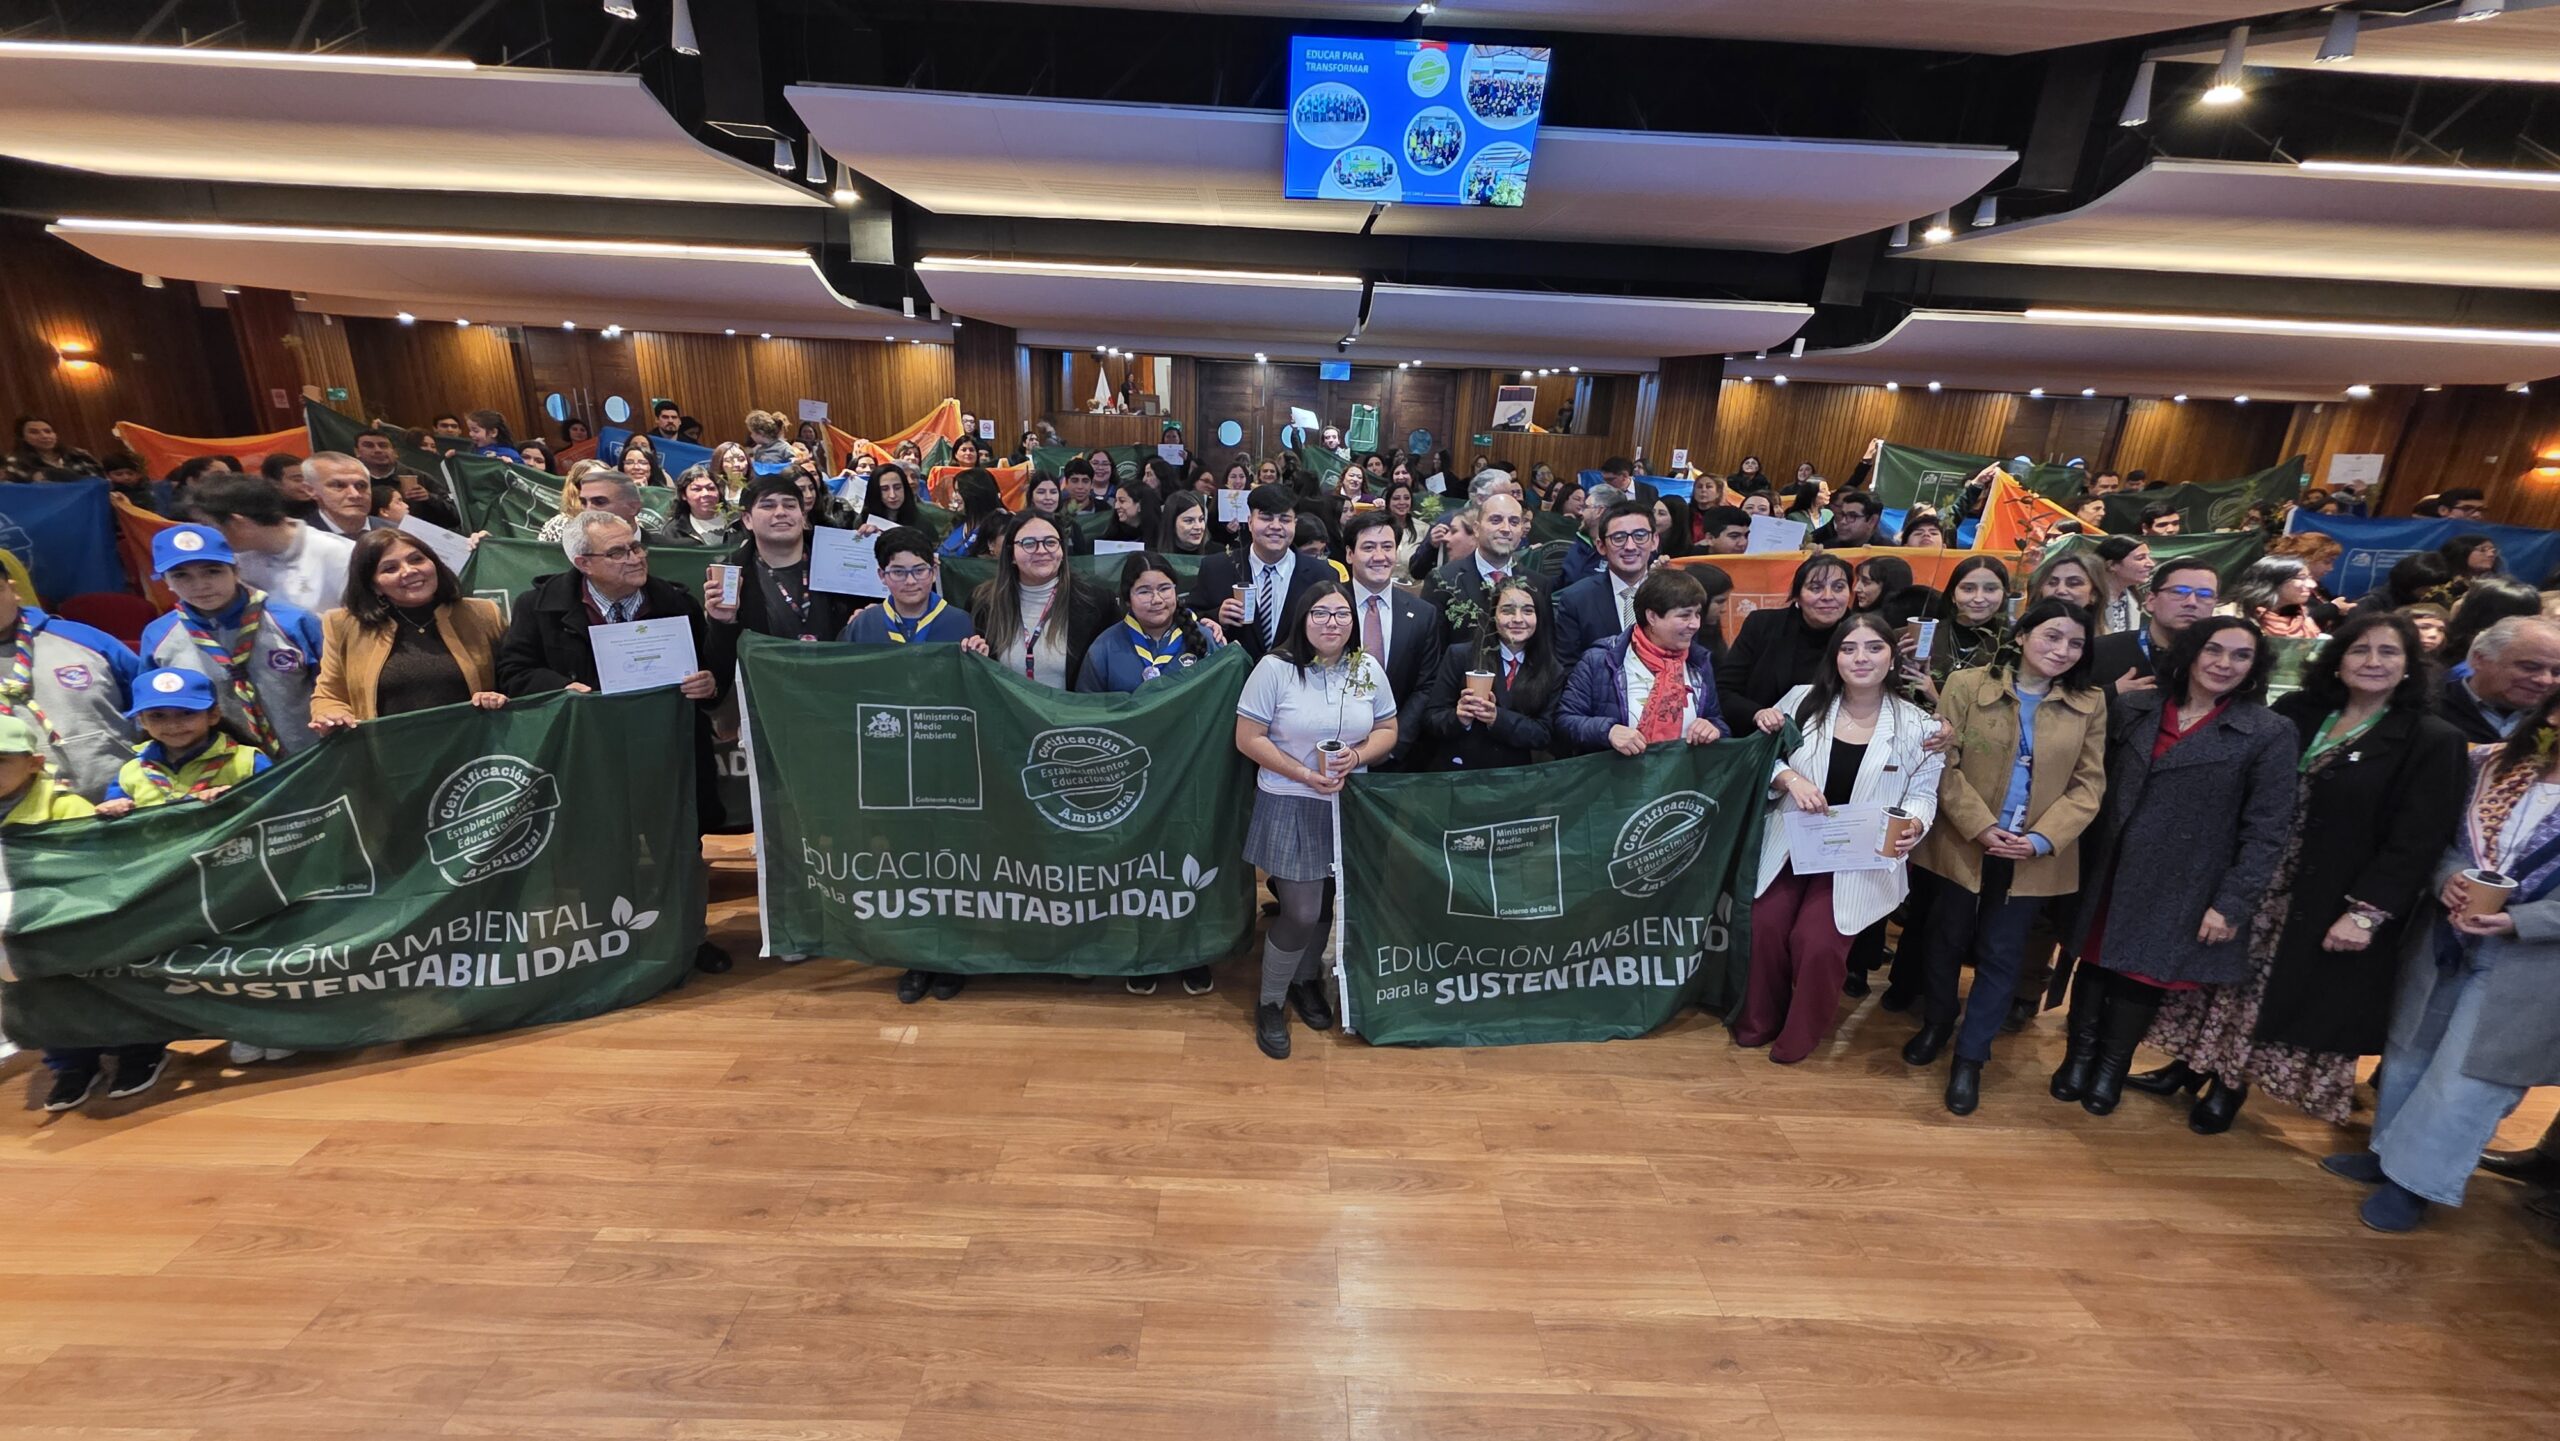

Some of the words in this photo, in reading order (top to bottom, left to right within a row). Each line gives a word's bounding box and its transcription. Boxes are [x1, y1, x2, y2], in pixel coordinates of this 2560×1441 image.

[1305, 49, 1340, 60] EDUCAR
[1342, 50, 1364, 61] PARA
[1305, 61, 1369, 74] TRANSFORMAR
[913, 712, 959, 721] Ministerio
[913, 722, 942, 731] Medio
[913, 731, 957, 740] Ambiente
[440, 765, 532, 819] Certificación
[1058, 790, 1136, 824] Ambiental
[1496, 825, 1538, 837] Ministerio
[1623, 799, 1705, 852] Certificación
[1496, 837, 1523, 846] Medio
[993, 851, 1175, 893] AMBIENTAL
[852, 887, 1196, 927] SUSTENTABILIDAD
[1499, 907, 1529, 916] Gobierno
[1538, 904, 1557, 913] Chile
[369, 902, 603, 966] AMBIENTAL
[164, 929, 630, 999] SUSTENTABILIDAD
[1377, 941, 1555, 977] EDUCACIÓN
[1376, 986, 1410, 1004] para
[1414, 980, 1428, 995] la
